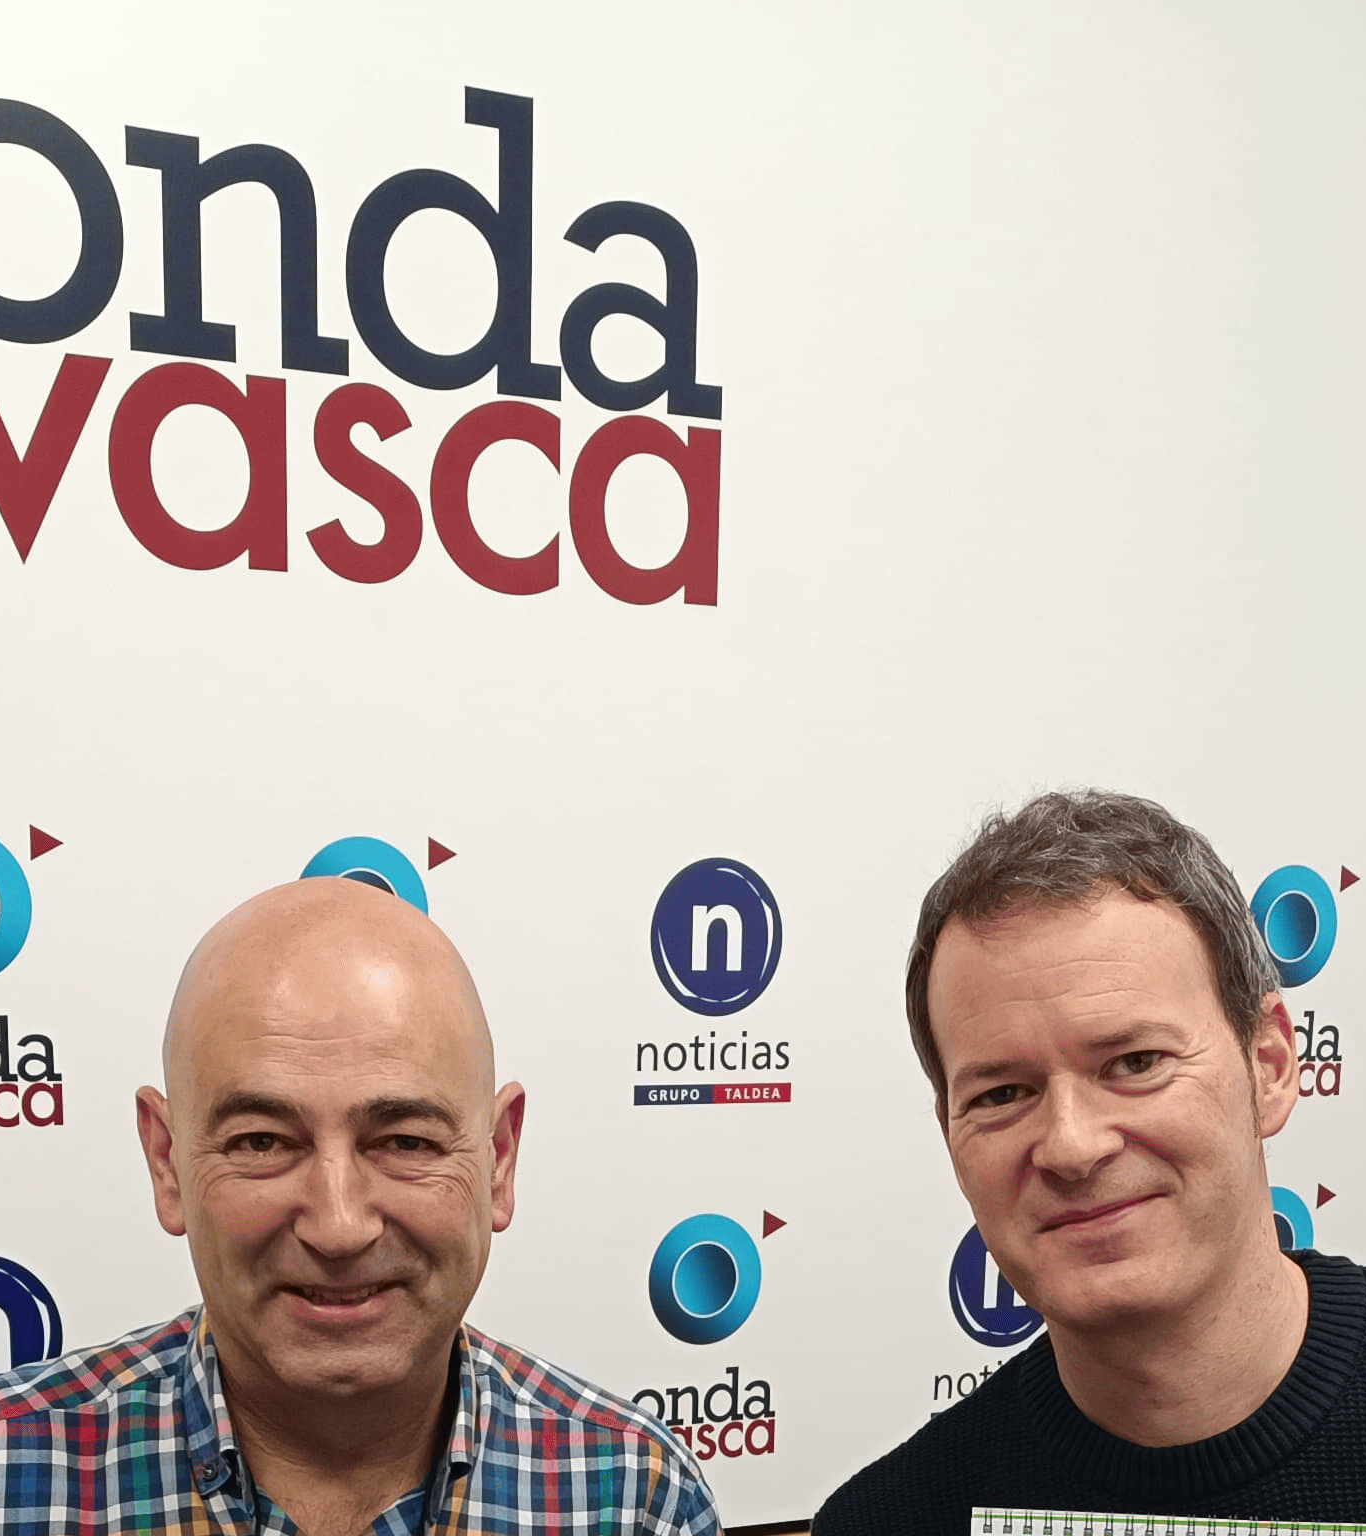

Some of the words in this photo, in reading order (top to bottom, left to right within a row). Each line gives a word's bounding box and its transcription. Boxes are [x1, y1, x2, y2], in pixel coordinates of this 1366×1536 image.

[636, 1030, 790, 1072] noticias
[1294, 1010, 1342, 1062] da
[648, 1088, 700, 1102] GRUPO
[724, 1087, 781, 1100] TALDEA
[635, 1366, 776, 1427] onda
[669, 1416, 776, 1461] asca
